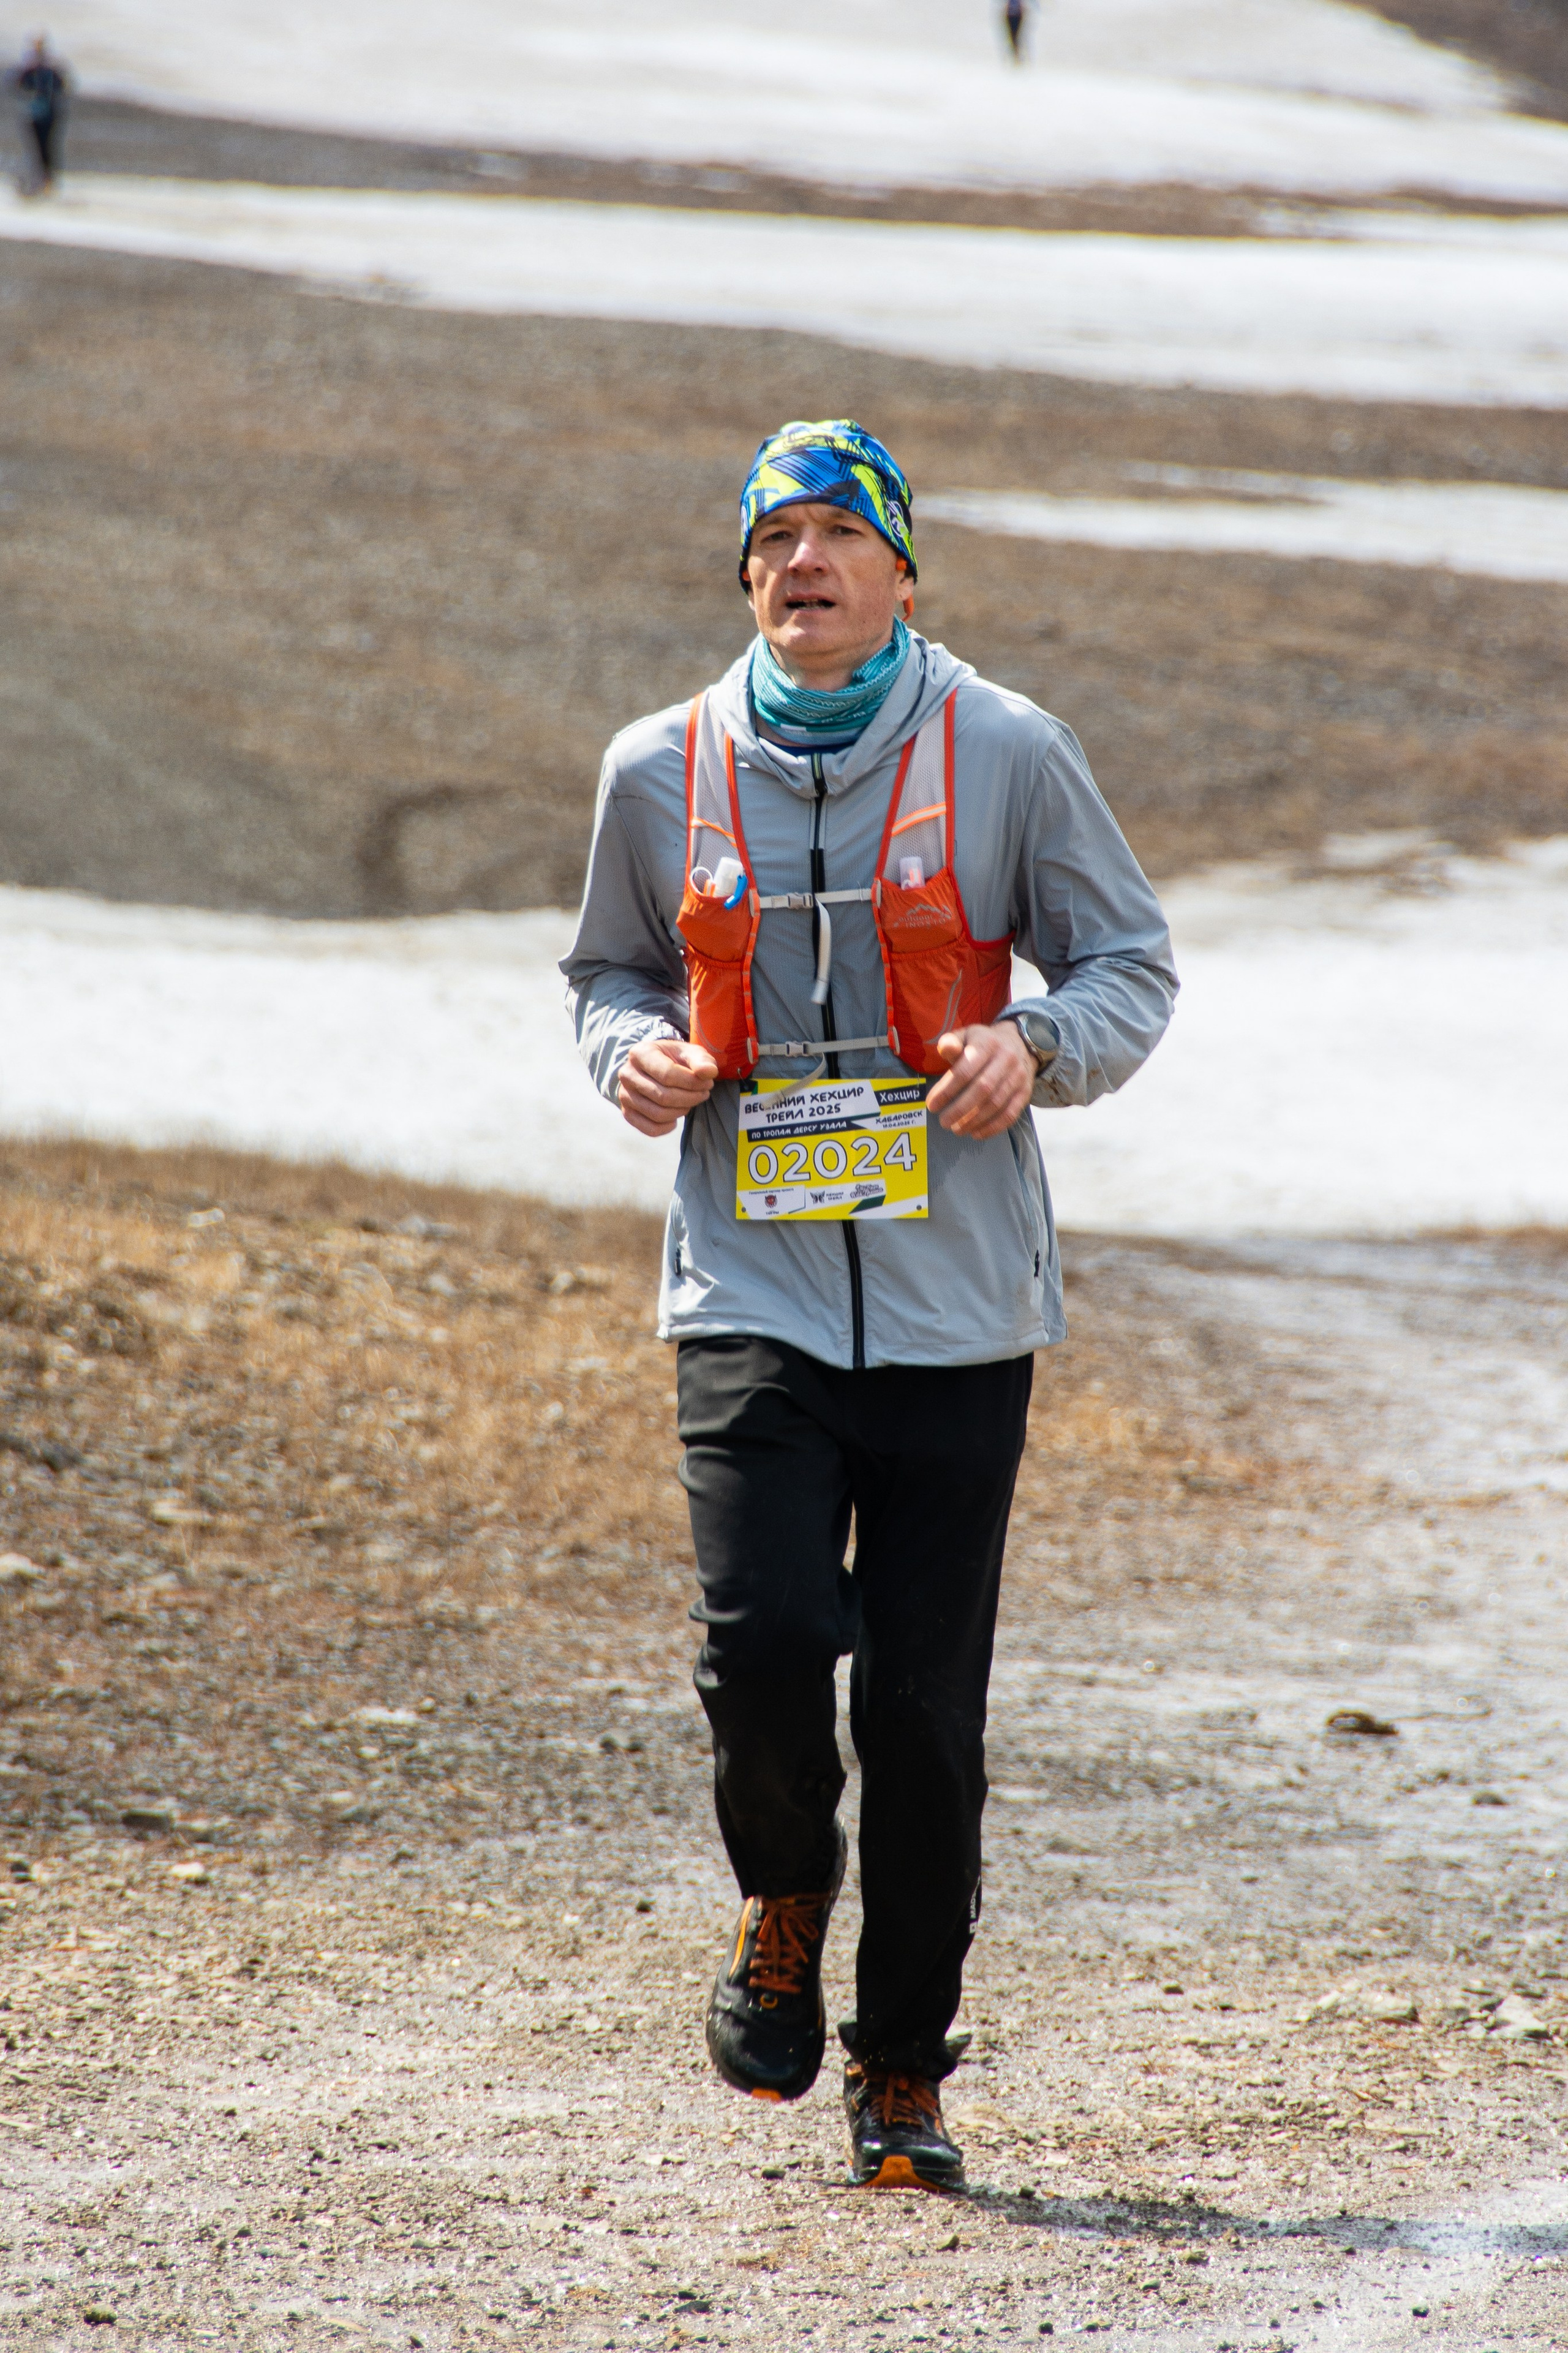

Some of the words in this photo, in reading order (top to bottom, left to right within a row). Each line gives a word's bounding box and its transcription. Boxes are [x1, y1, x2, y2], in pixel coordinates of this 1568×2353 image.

[745, 1094, 805, 1114] ВЕСННИЙ
[810, 1087, 864, 1103] ХЕХЦИР
[880, 1089, 920, 1103] Хехцир
[766, 1108, 804, 1123] ТРЕЙЛ
[809, 1103, 841, 1117] 2025
[875, 1110, 923, 1124] ХАБАРОВСК
[752, 1131, 761, 1139] ПО
[763, 1128, 791, 1138] ТРОПАМ
[793, 1125, 818, 1135] ДЕРСУ
[820, 1120, 847, 1131] УЗАЛА
[748, 1132, 918, 1185] 02024
